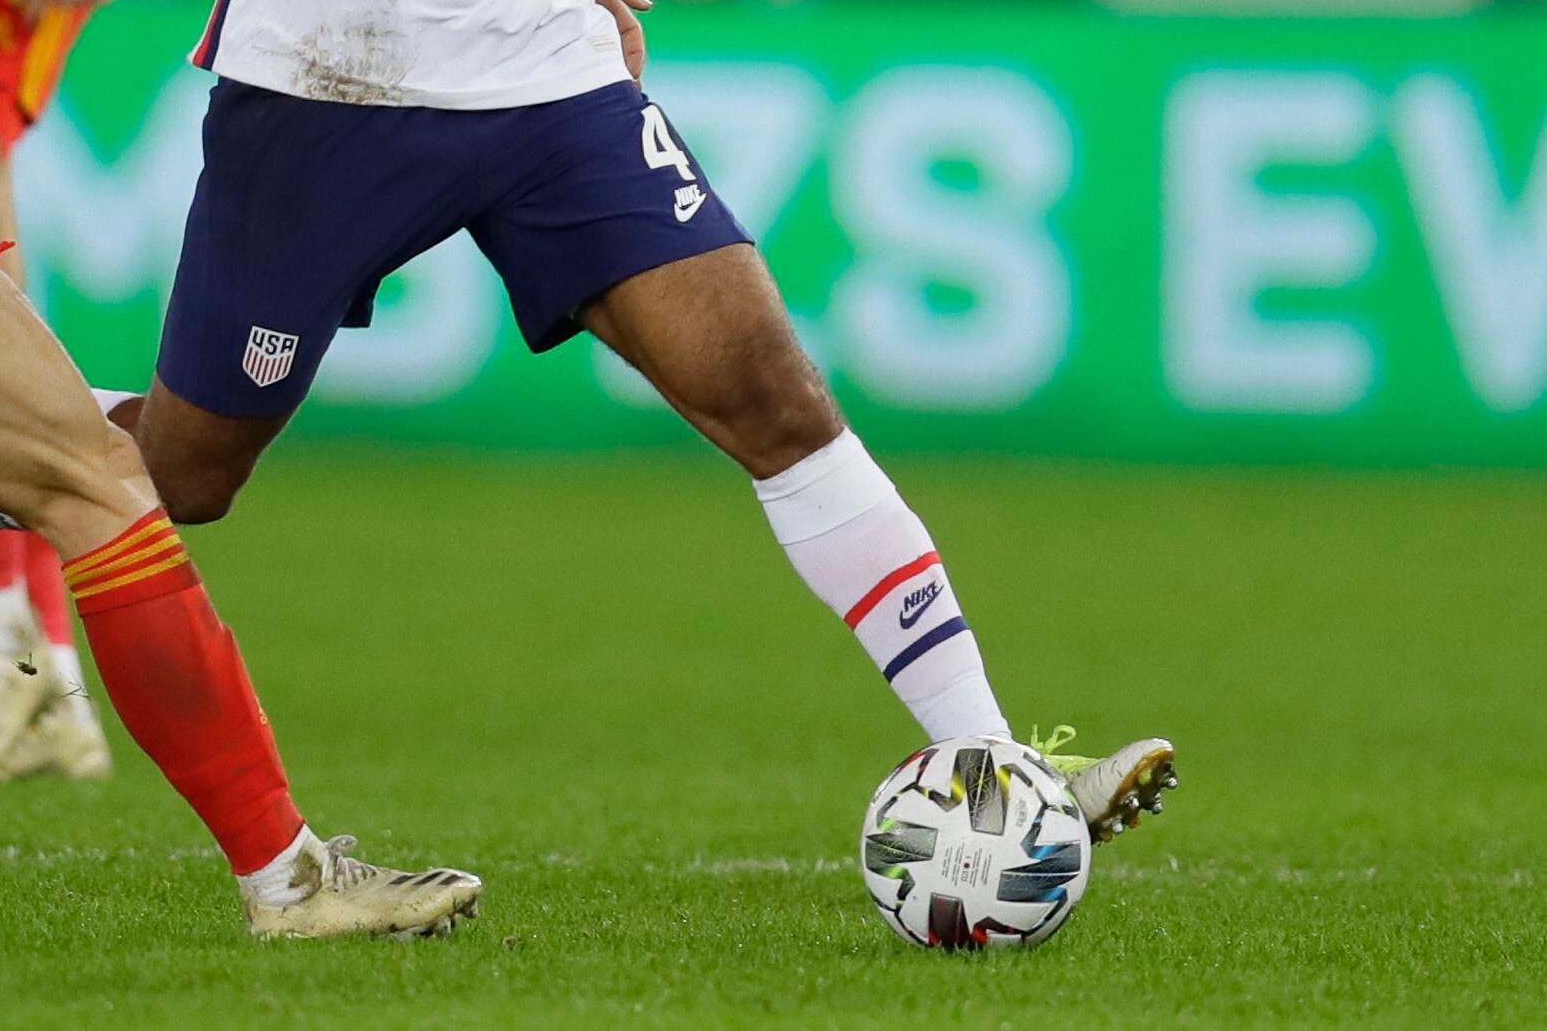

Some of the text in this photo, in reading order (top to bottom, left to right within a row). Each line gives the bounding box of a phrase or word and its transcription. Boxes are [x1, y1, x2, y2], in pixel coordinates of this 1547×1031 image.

[641, 104, 697, 181] 4
[674, 184, 701, 208] NIKE
[252, 330, 296, 356] USA
